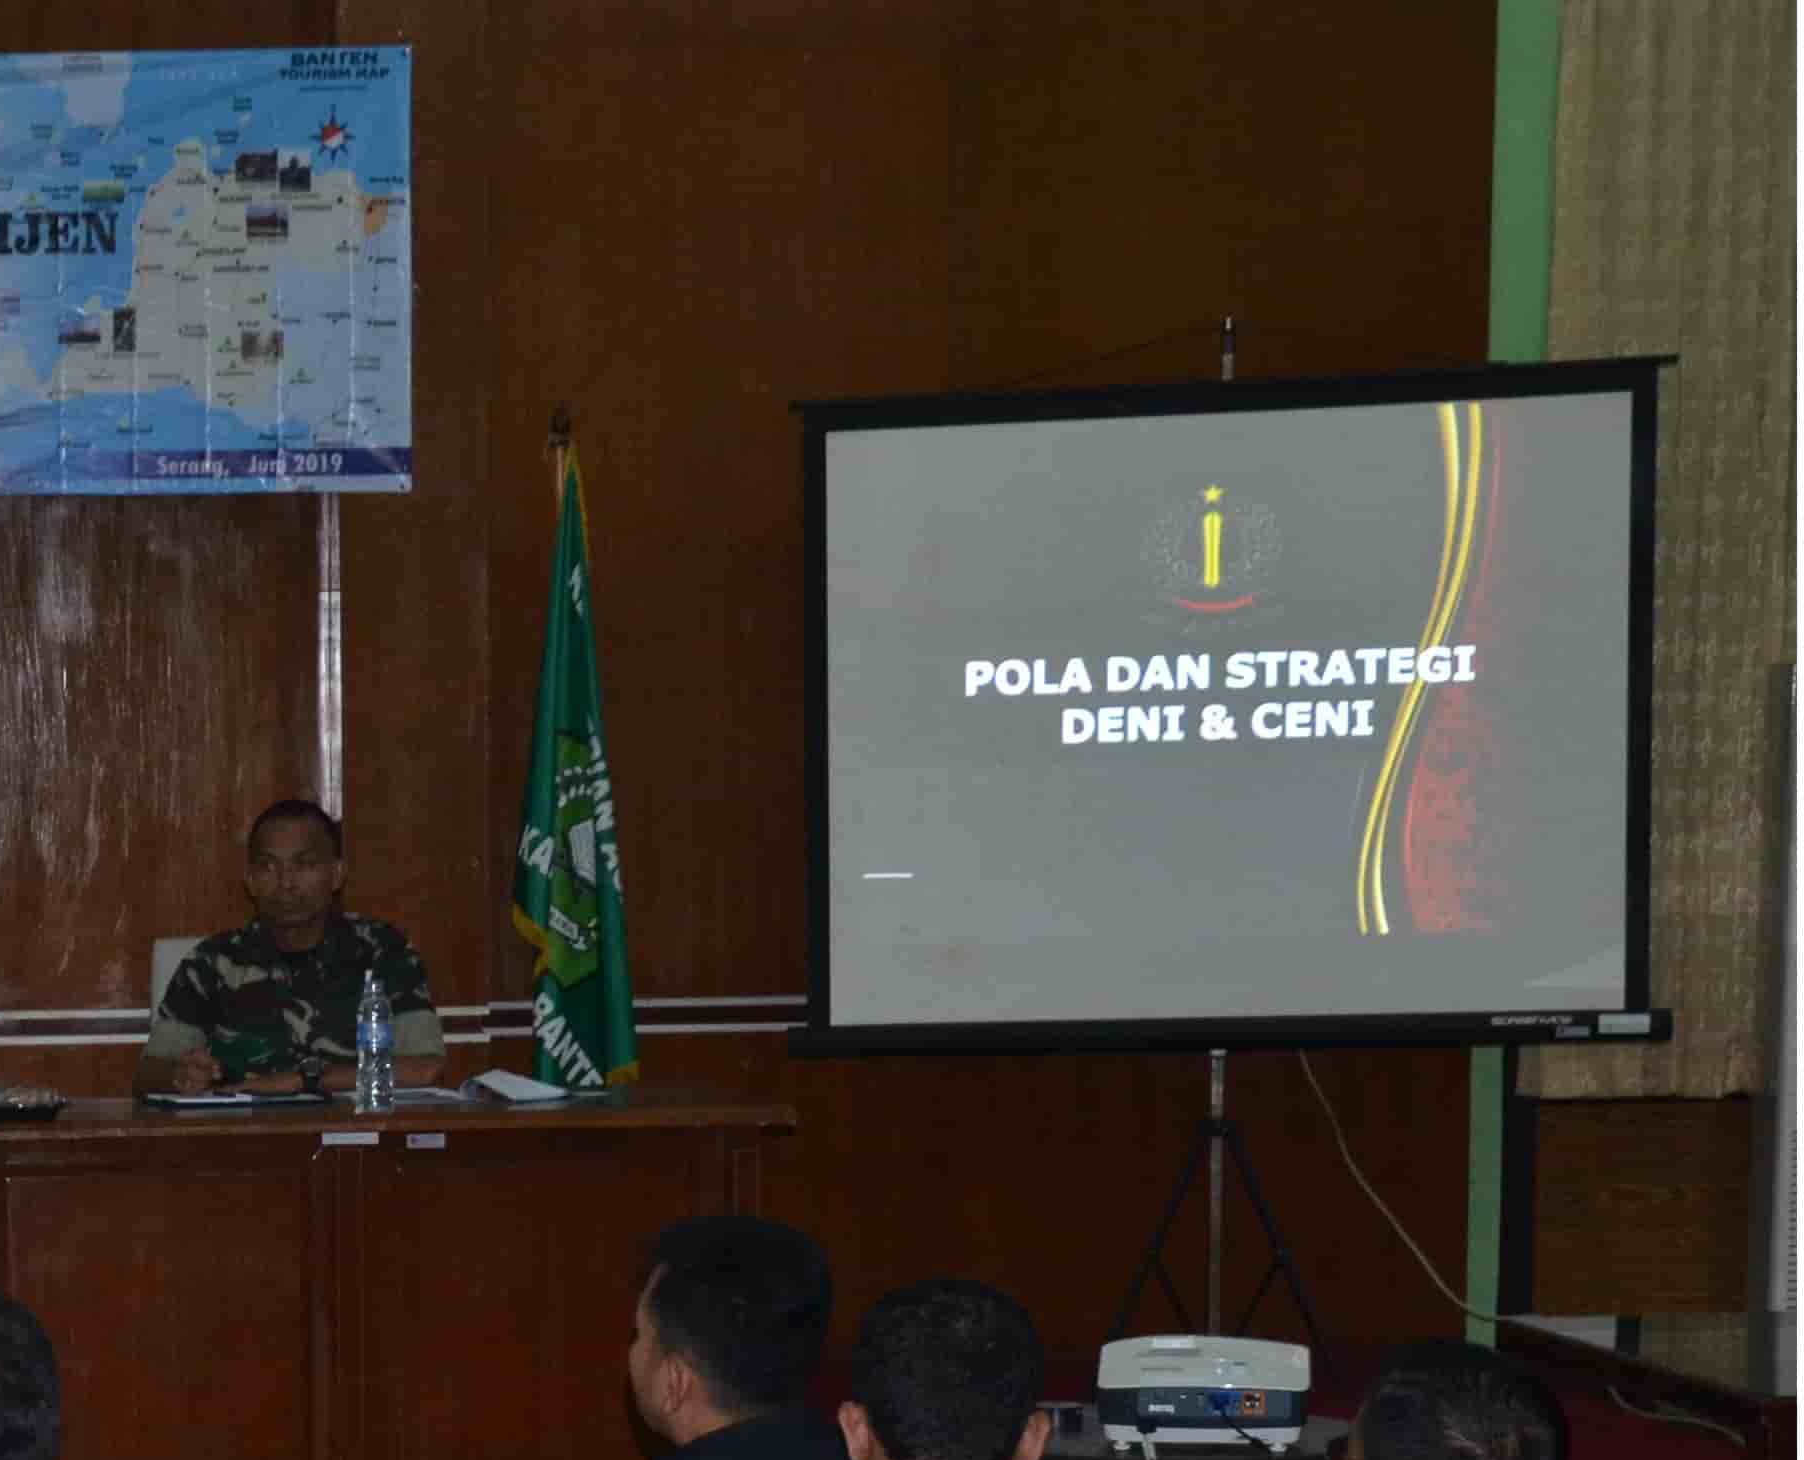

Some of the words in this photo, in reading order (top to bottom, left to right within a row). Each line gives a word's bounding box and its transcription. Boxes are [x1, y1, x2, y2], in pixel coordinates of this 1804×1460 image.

[290, 51, 379, 66] BANTEN
[293, 453, 344, 473] 2019
[965, 657, 1092, 696] POLA
[1107, 653, 1210, 692] DAN
[1225, 645, 1476, 690] STRATEGI
[1062, 705, 1184, 744] DENI
[1200, 704, 1237, 741] &
[1251, 699, 1374, 739] CENI
